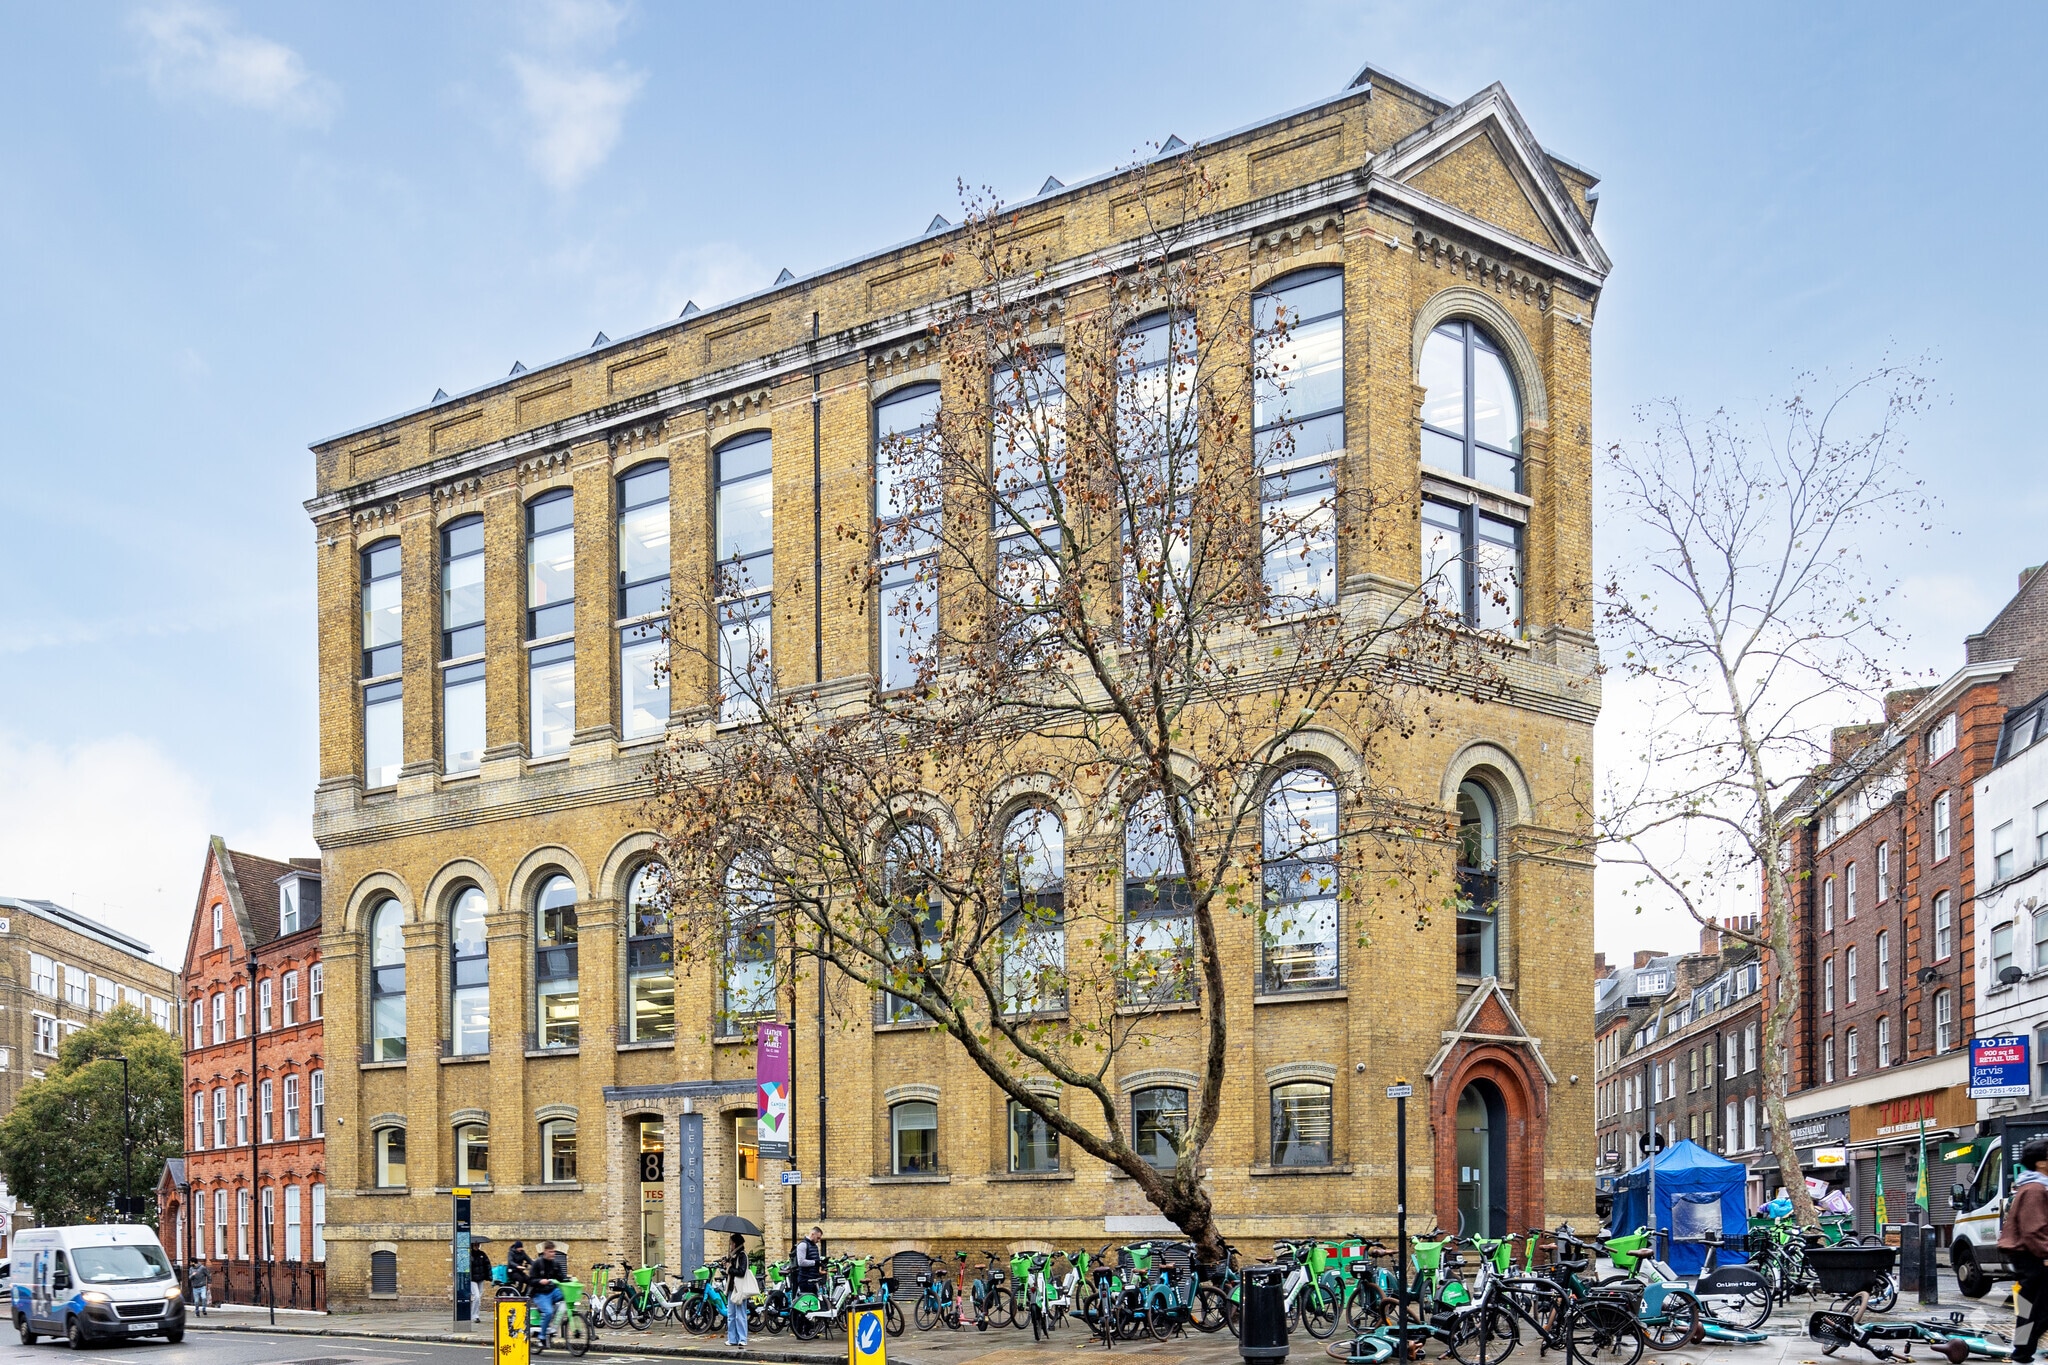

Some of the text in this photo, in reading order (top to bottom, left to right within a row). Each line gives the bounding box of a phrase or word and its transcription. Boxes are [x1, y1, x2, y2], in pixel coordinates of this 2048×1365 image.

[1979, 1037, 2019, 1048] TO LET
[1979, 1054, 2020, 1063] RETAIL USE
[1973, 1065, 2003, 1078] Jarvis
[1972, 1076, 2004, 1086] Keller
[1797, 1123, 1826, 1137] RESTAURANT
[1943, 1144, 1974, 1161] SUBWAY
[645, 1190, 664, 1199] TES
